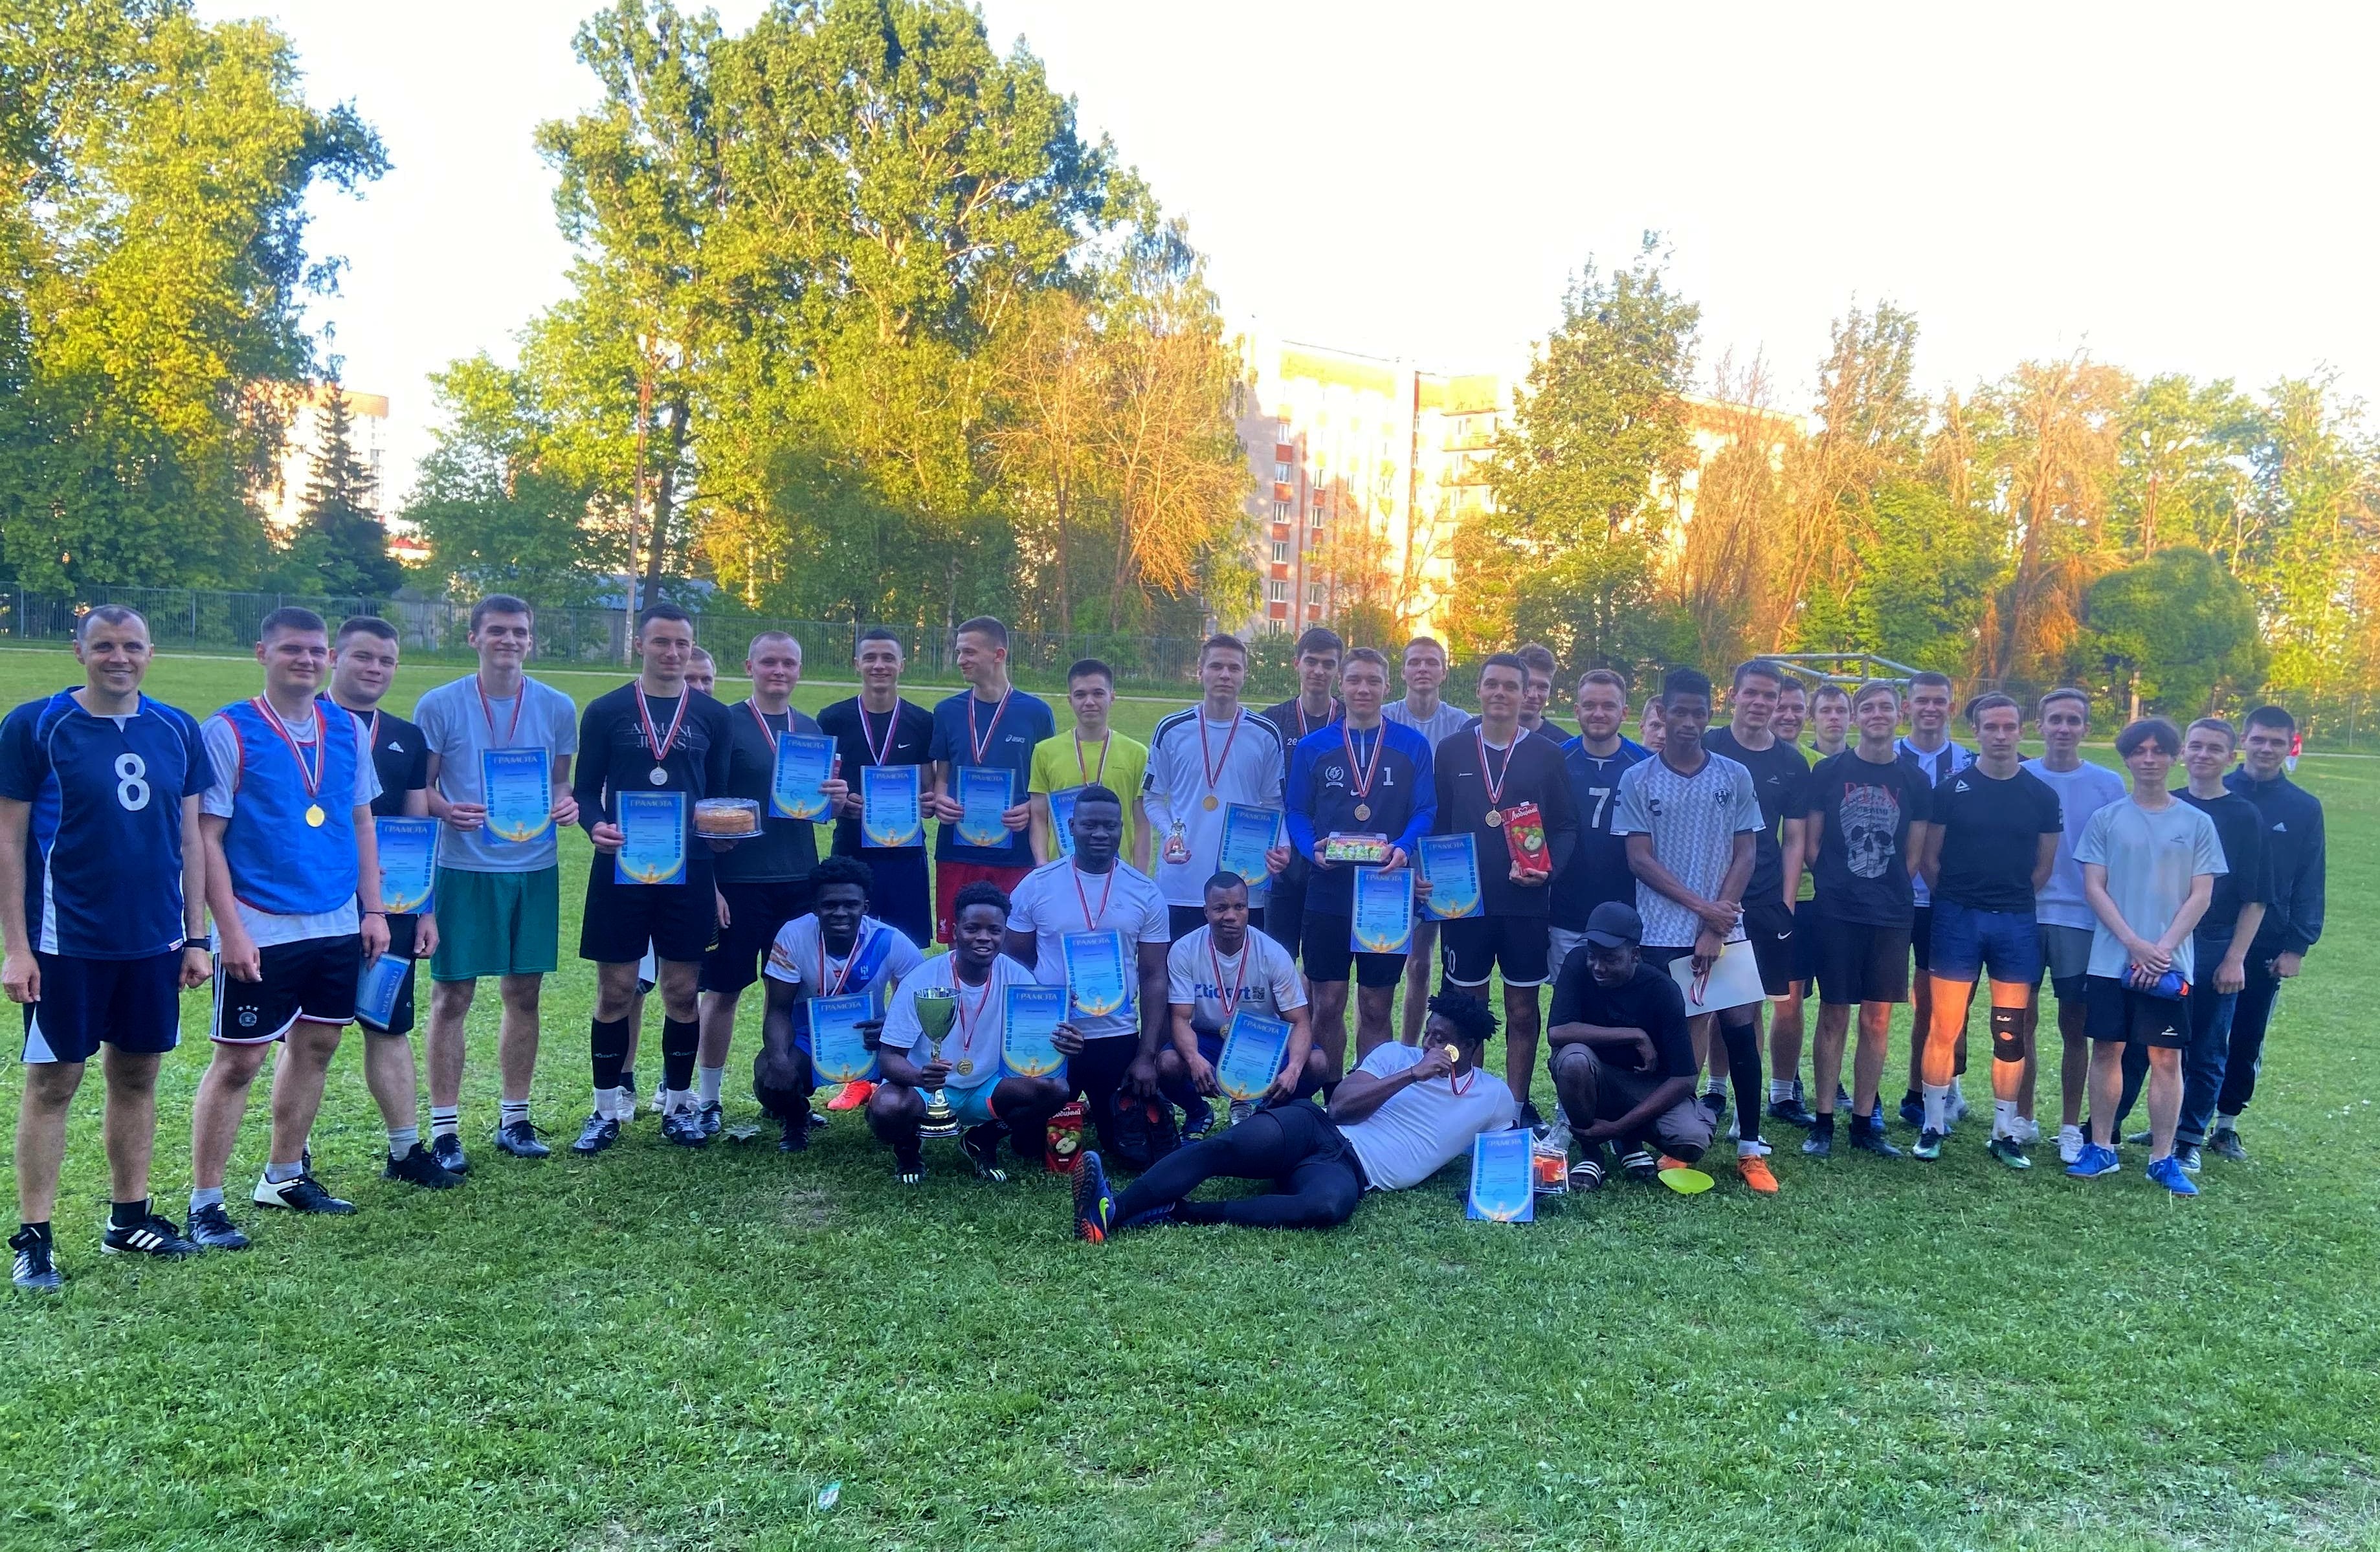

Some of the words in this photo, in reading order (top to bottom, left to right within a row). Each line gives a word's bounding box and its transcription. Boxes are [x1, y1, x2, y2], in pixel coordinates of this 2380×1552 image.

[630, 722, 692, 738] AMNI
[494, 756, 538, 764] ГРАМОТА
[115, 753, 150, 811] 8
[1383, 767, 1394, 786] 1
[630, 799, 673, 808] ГРАМОТА
[1588, 787, 1610, 828] 7
[1236, 811, 1271, 822] ГРАМОТА
[384, 825, 427, 834] ГРАМОТА
[1429, 841, 1465, 850] ГРАМОТА
[1072, 938, 1111, 946] ГРАМОТА
[821, 1001, 862, 1012] ГРАМОТА
[1243, 1019, 1280, 1035] ГРАМОТА
